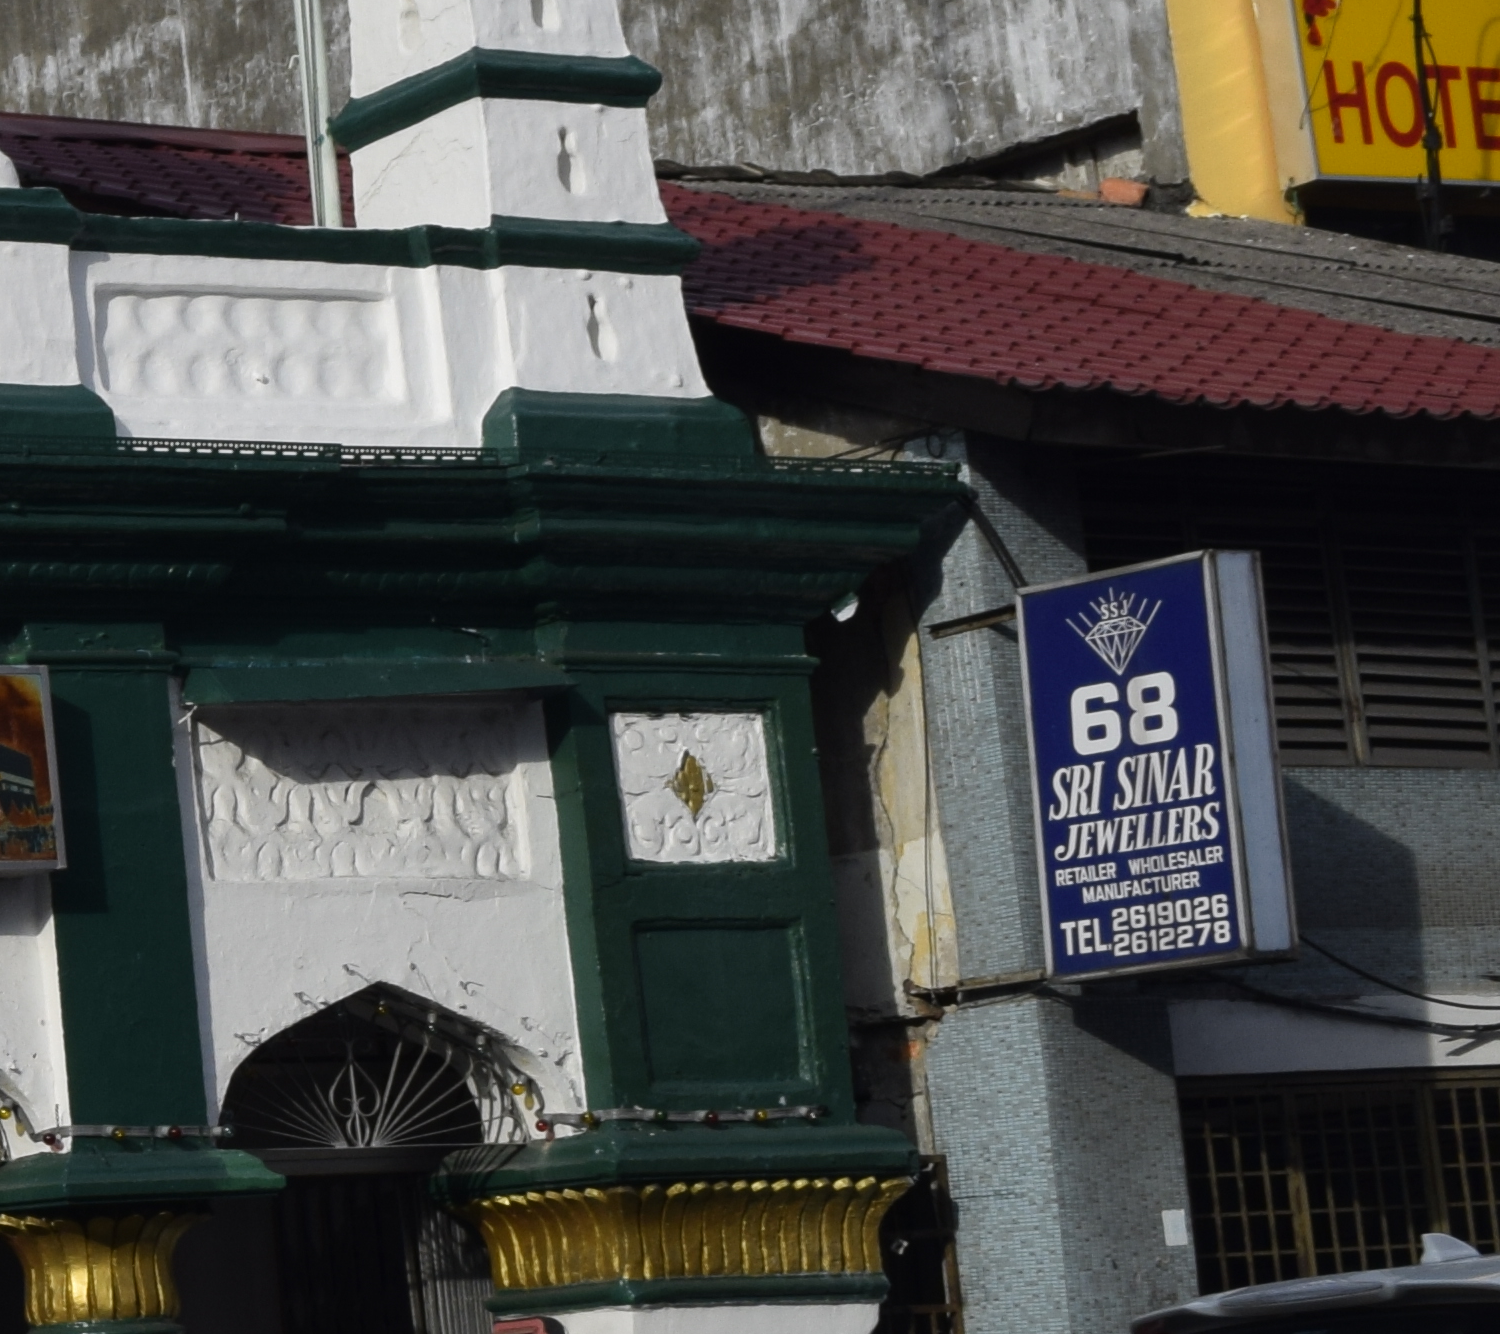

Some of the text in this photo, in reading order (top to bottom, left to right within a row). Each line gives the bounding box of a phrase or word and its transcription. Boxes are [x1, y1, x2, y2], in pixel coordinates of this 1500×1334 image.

[1100, 600, 1129, 618] SSJ
[1070, 671, 1178, 756] 68
[1048, 743, 1216, 821] SRI SINAR
[1054, 801, 1220, 861] JEWELLERS
[1055, 846, 1223, 887] RETAILER WHOLESALER
[1082, 871, 1200, 904] MANUFACTURER
[1061, 893, 1229, 956] TEL. 2619026
[1113, 921, 1231, 957] 2612278
